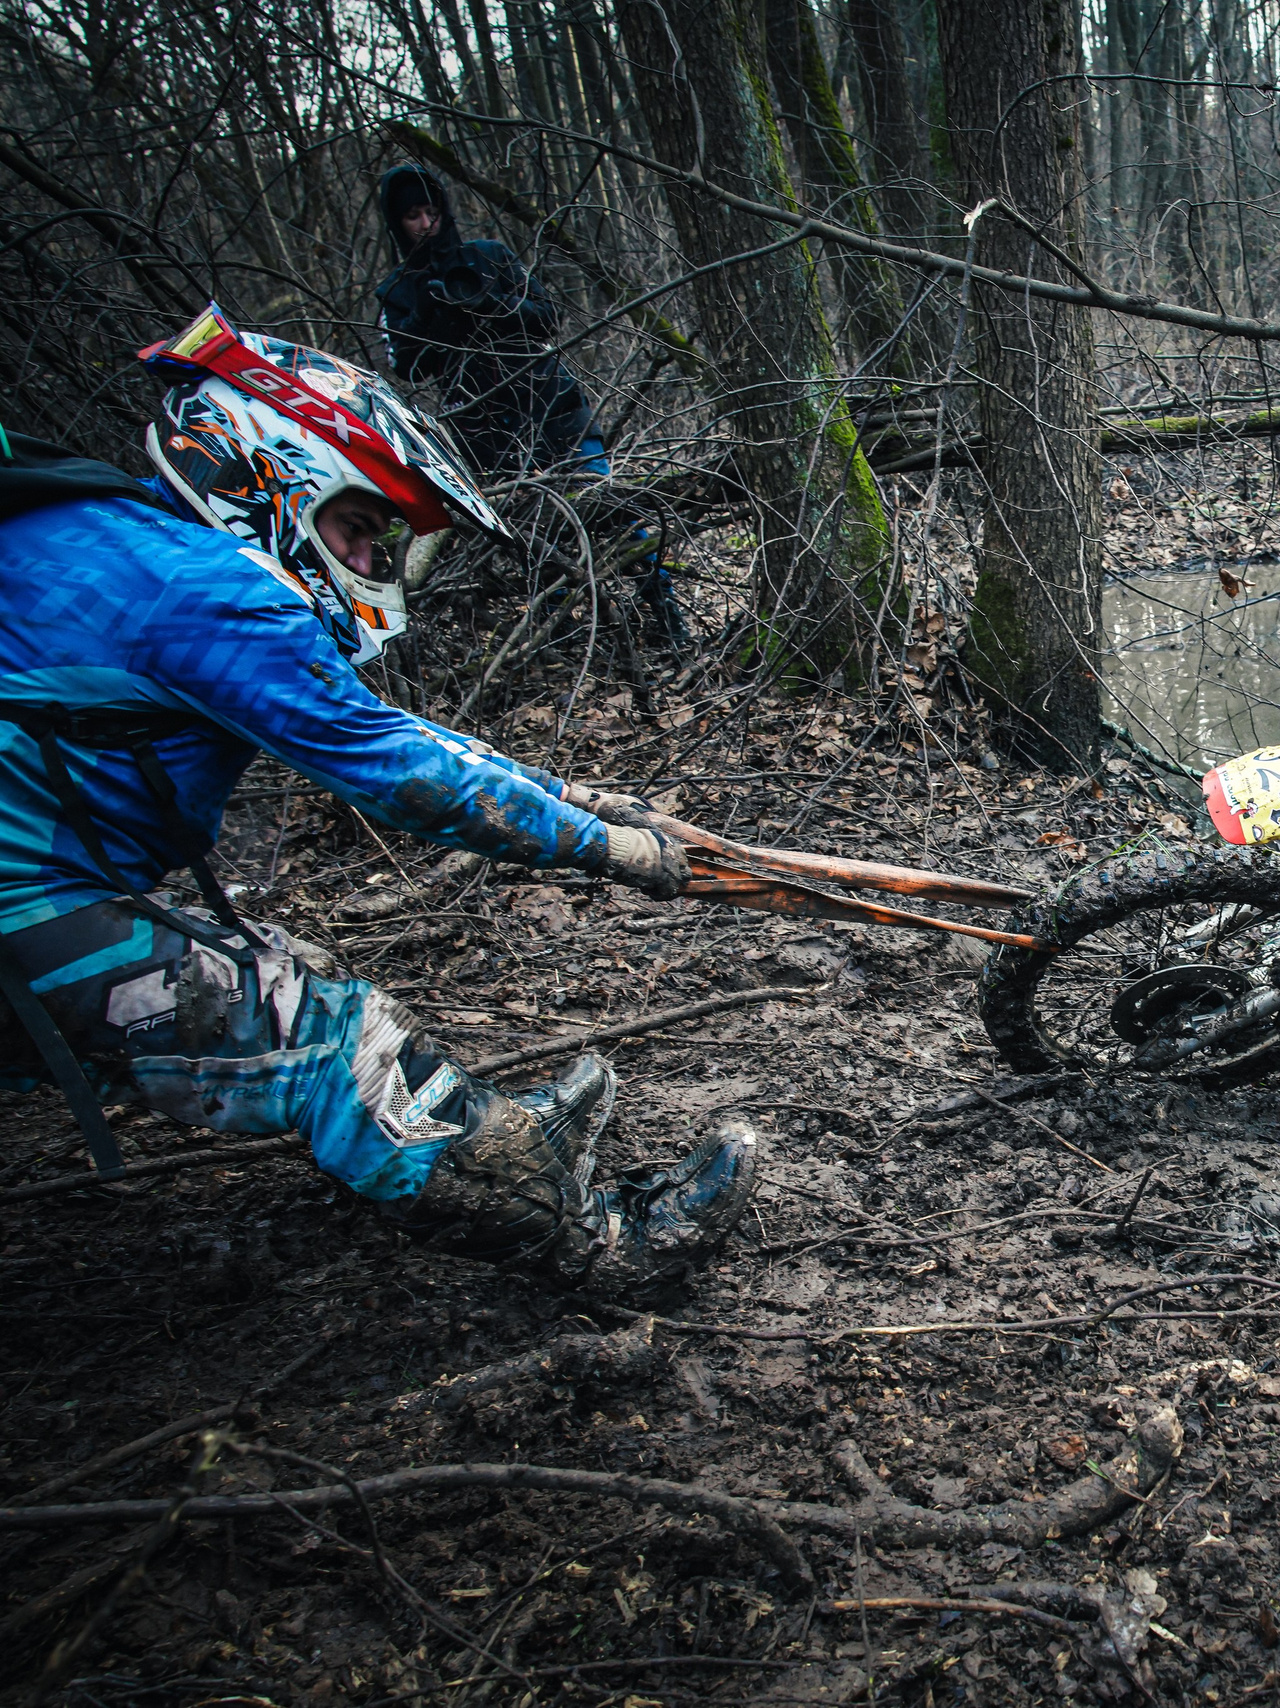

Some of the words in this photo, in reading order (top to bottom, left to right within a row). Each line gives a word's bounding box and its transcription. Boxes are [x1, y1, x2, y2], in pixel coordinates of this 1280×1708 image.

[240, 367, 372, 447] GTX
[428, 461, 469, 497] LAZER
[297, 567, 345, 617] LAZER
